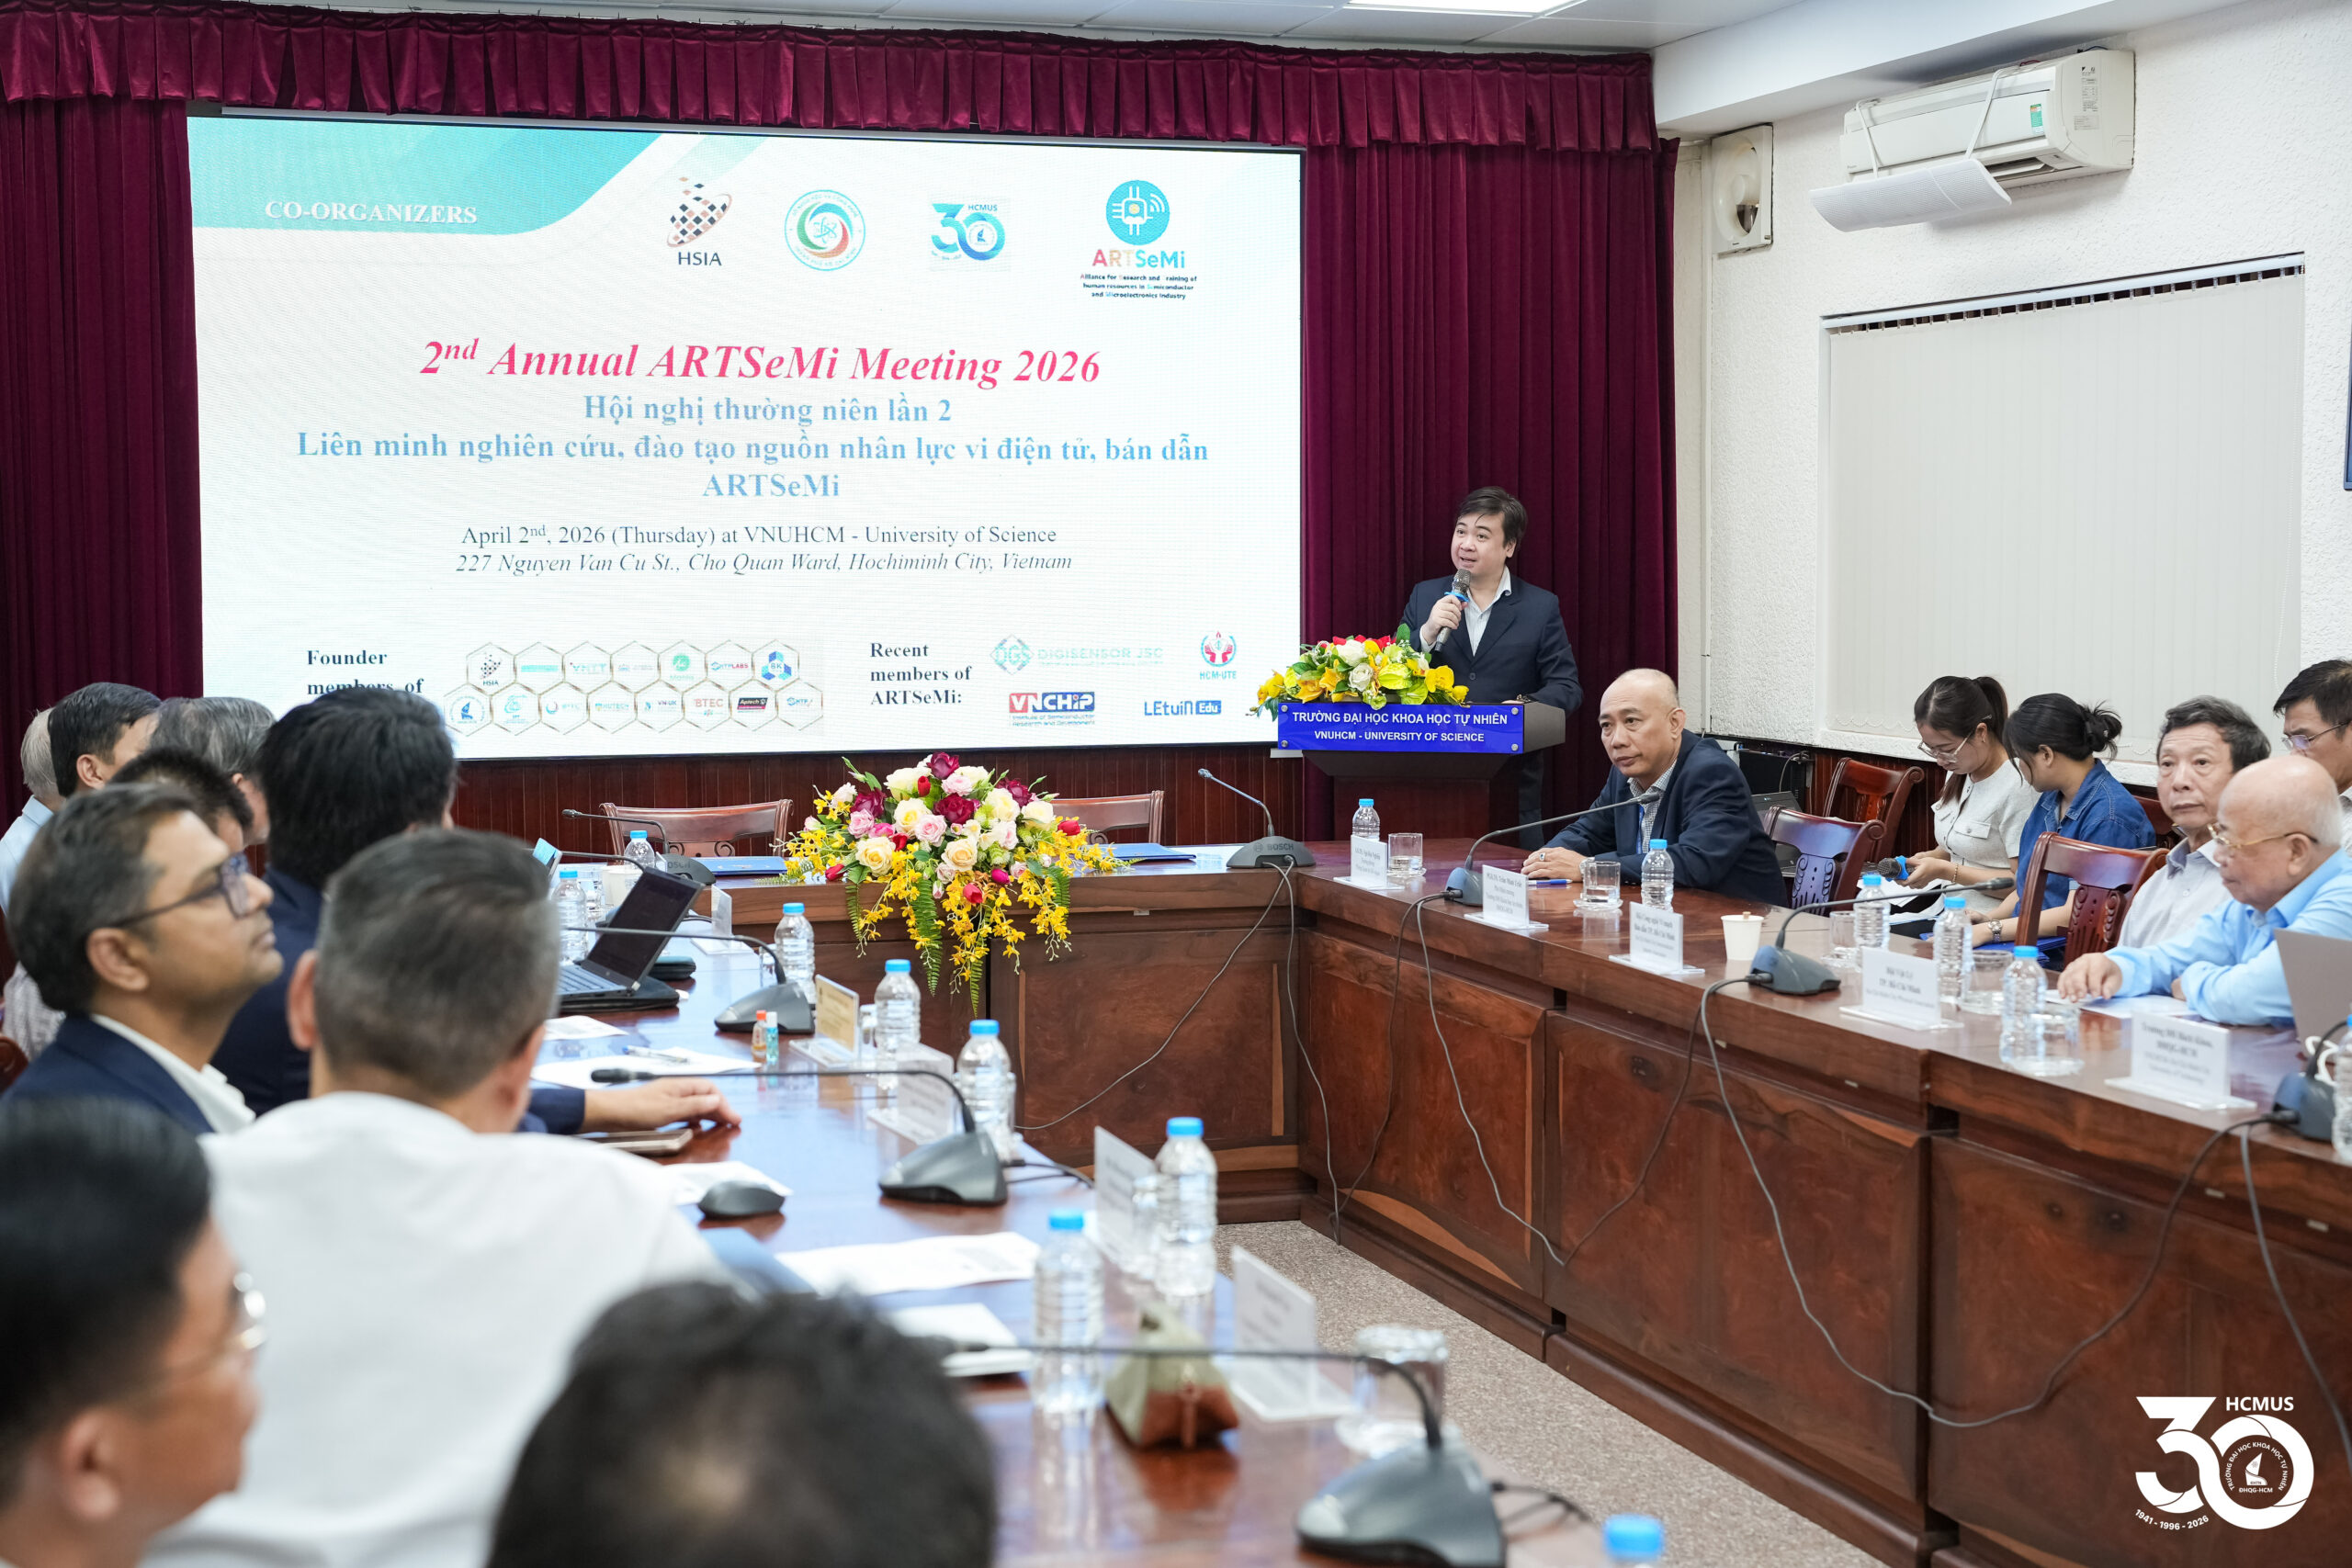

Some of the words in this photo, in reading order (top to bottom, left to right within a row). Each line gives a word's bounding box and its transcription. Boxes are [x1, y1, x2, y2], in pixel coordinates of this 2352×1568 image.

[265, 200, 479, 225] CO-ORGANIZERS
[677, 251, 723, 266] HSIA
[1091, 249, 1185, 269] ARTSeMi
[419, 338, 480, 375] 2nd
[488, 344, 639, 377] Annual
[646, 344, 841, 380] ARTSeMi
[849, 347, 1002, 389] Meeting
[1012, 350, 1102, 382] 2026
[584, 394, 633, 424] Hội
[643, 396, 704, 426] nghị
[714, 399, 813, 427] thường
[822, 399, 878, 422] niên
[888, 392, 928, 422] lần
[938, 400, 952, 422] 2
[298, 433, 363, 457] Liên
[373, 434, 448, 457] minh
[458, 434, 554, 463] nghiên
[564, 434, 625, 458] cứu,
[634, 434, 684, 458] đào
[694, 437, 736, 465] tạo
[746, 429, 829, 465] nguồn
[840, 436, 906, 460] nhân
[916, 436, 956, 466] lực
[965, 438, 989, 460] vi
[997, 438, 1052, 466] điện
[1061, 436, 1097, 462] tử,
[1105, 437, 1152, 461] bán
[1161, 432, 1208, 461] dẫn
[702, 473, 841, 498] ARTSeMi
[461, 526, 512, 548] April
[518, 525, 551, 546] 2nd,
[559, 526, 605, 544] 2026
[612, 525, 716, 548] (Thursday)
[722, 529, 738, 544] at
[745, 526, 844, 544] VNUHCM
[865, 526, 958, 547] University
[965, 526, 985, 544] of
[989, 526, 1057, 544] Science
[456, 555, 492, 572] 227
[498, 555, 571, 578] Nguyen
[579, 555, 613, 571] Van
[619, 555, 646, 571] Cu
[652, 555, 681, 573] St.,
[689, 554, 727, 571] Cho
[733, 555, 784, 575] Quan
[792, 554, 842, 571] Ward,
[849, 553, 948, 571] Hochiminh
[955, 553, 993, 574] City,
[1002, 553, 1072, 570] Vietnam
[307, 649, 388, 665] Founder
[870, 642, 929, 658] Recent
[870, 666, 949, 682] members
[955, 666, 972, 682] of
[1199, 671, 1238, 681] HCM-UTE
[405, 678, 424, 694] of
[870, 690, 963, 705] ARTSeMi:
[1199, 702, 1218, 714] Edu
[1293, 710, 1340, 723] TRƯỜNG
[1343, 713, 1362, 725] ĐẠI
[1364, 713, 1389, 725] HỌC
[1392, 714, 1424, 724] KHOA
[1426, 714, 1451, 726] HỌC
[1453, 714, 1471, 726] TỰ
[1473, 712, 1508, 725] NHIÊN
[1314, 730, 1356, 740] VNUHCM
[1364, 731, 1422, 741] UNIVERSITY
[1424, 732, 1438, 741] OF
[1441, 732, 1485, 742] SCIENCE
[1267, 843, 1295, 852] BOSCH
